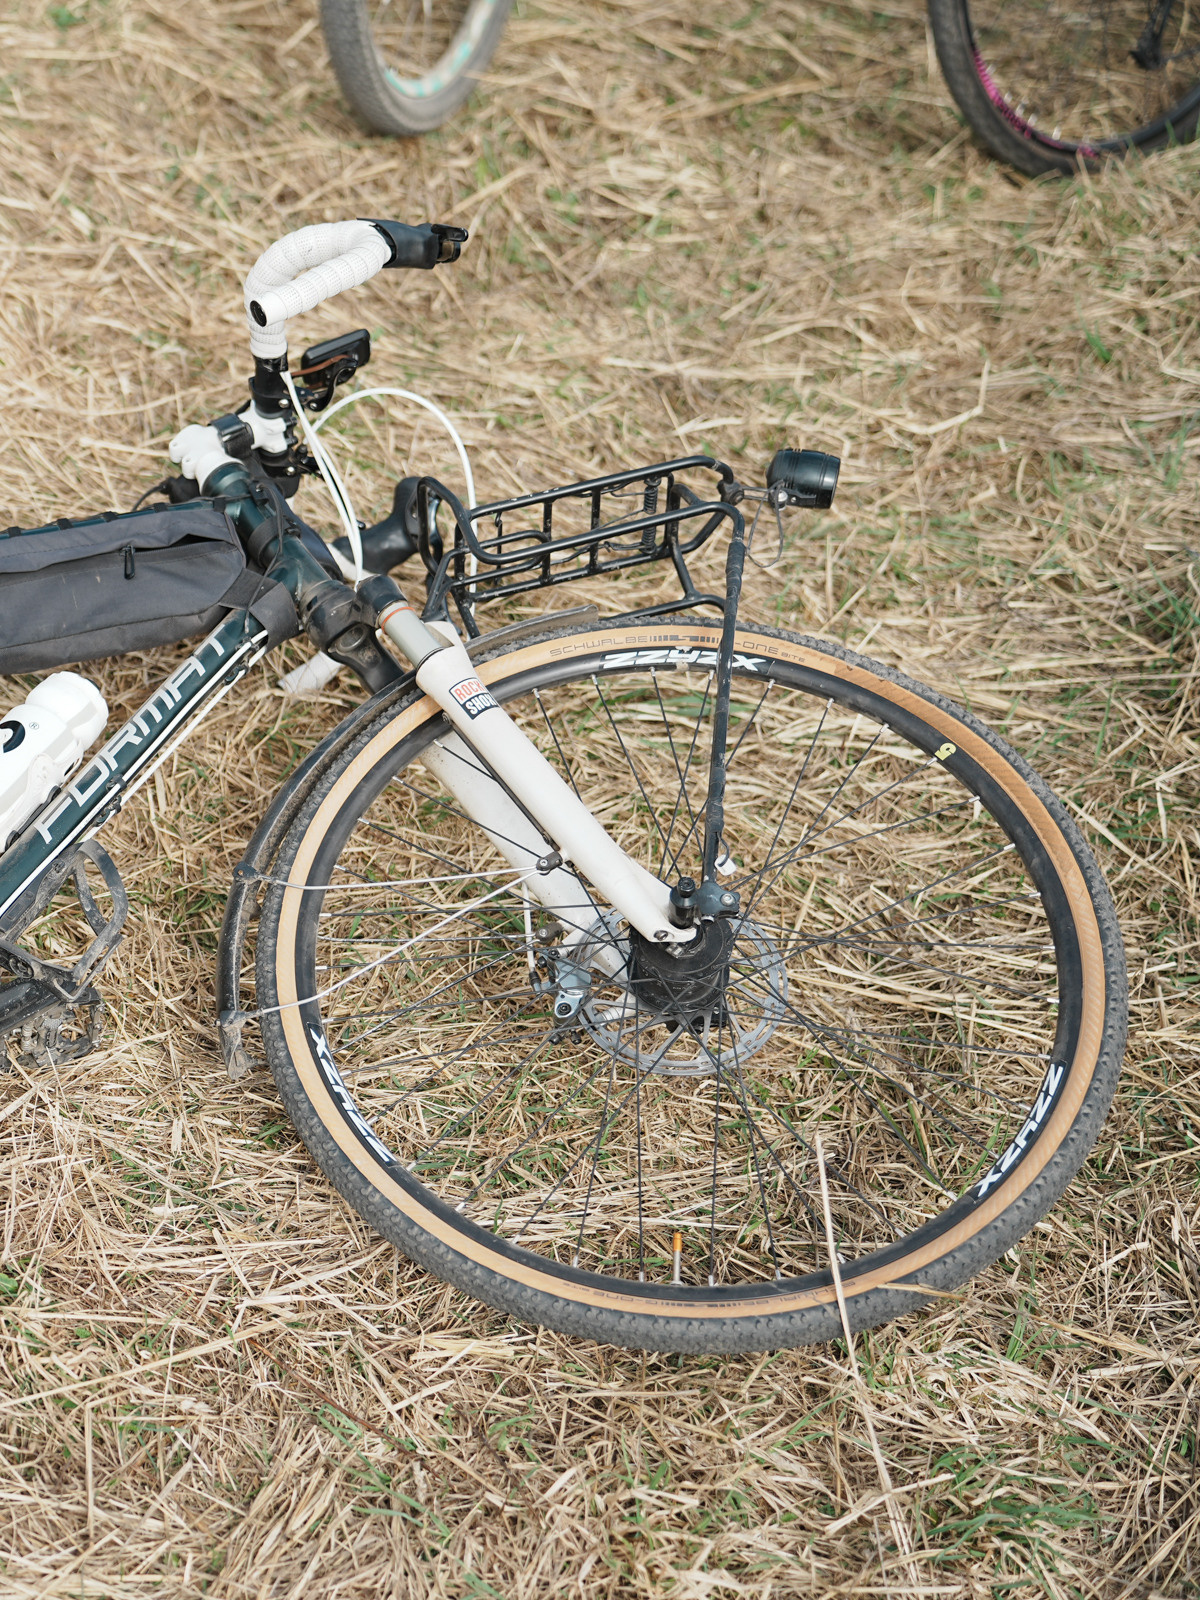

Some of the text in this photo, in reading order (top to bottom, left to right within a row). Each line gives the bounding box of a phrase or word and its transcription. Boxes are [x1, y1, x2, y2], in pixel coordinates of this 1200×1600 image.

[549, 635, 648, 657] SCHWALBE
[735, 641, 779, 655] -ONE
[603, 649, 767, 672] ZZYZX
[453, 680, 486, 702] ROCK
[465, 693, 498, 715] SHOX
[33, 623, 225, 844] FORMAT
[309, 1027, 398, 1163] ZZYZX
[973, 1063, 1064, 1198] ZZYZX
